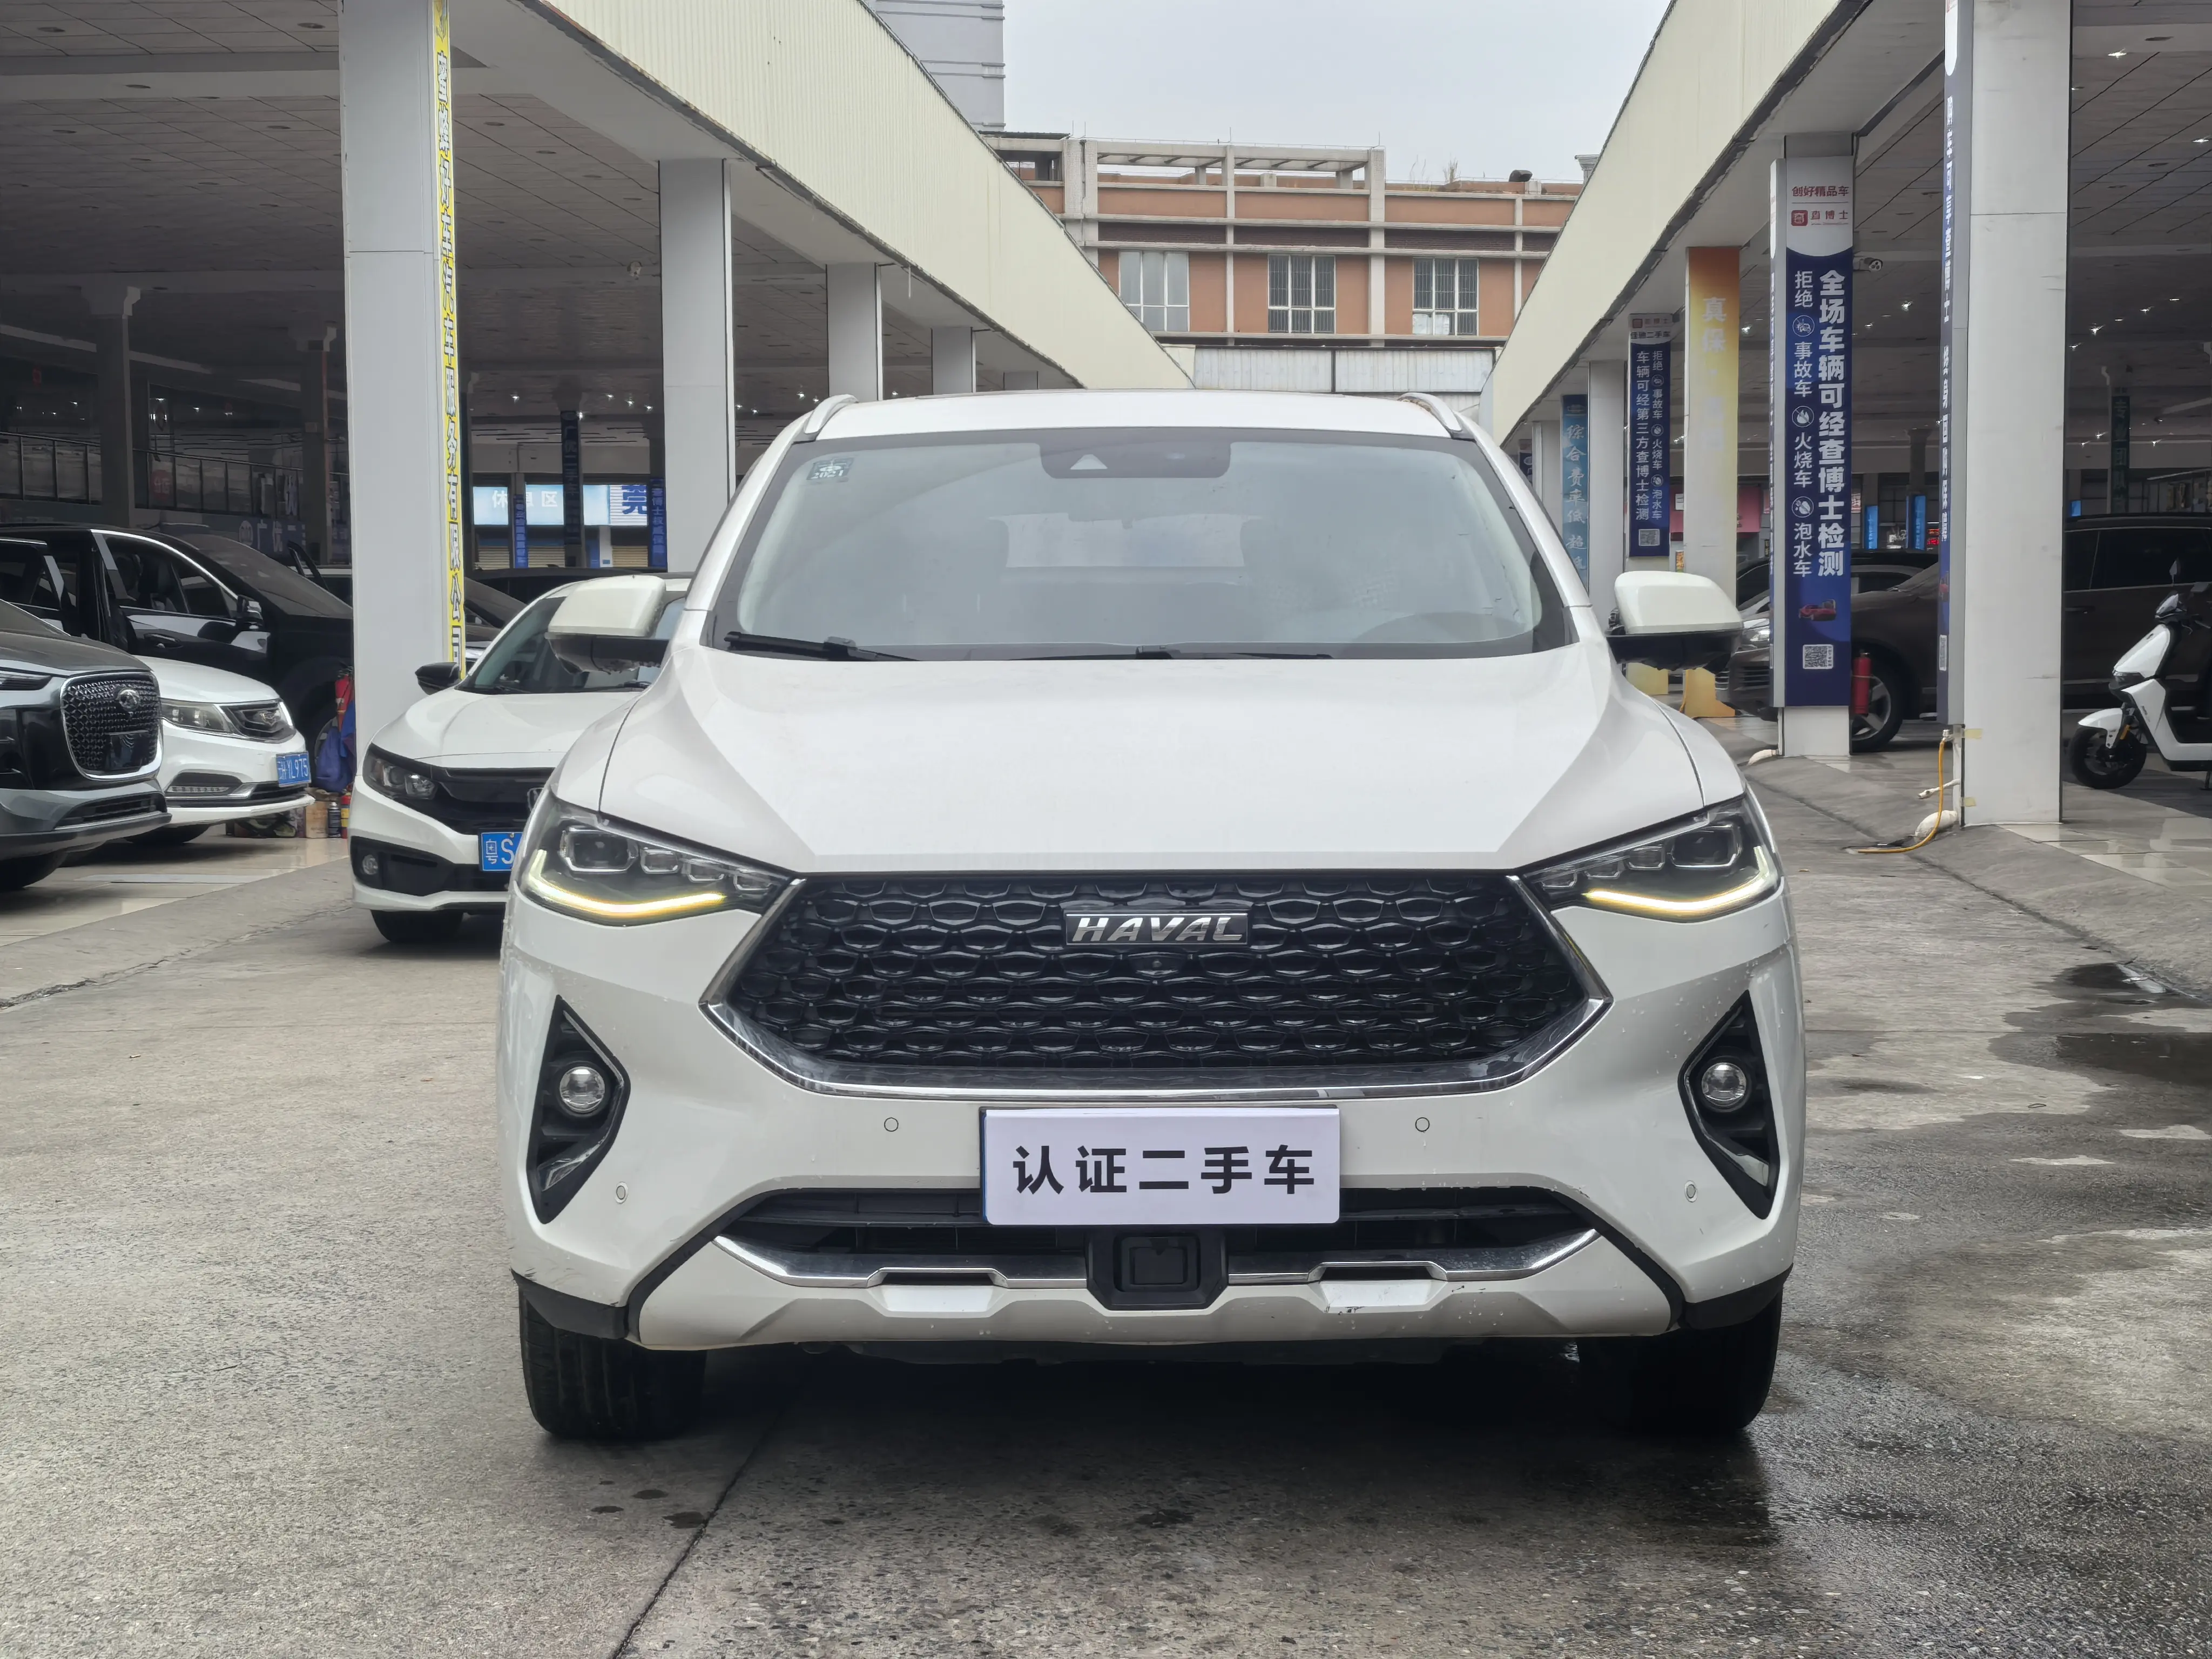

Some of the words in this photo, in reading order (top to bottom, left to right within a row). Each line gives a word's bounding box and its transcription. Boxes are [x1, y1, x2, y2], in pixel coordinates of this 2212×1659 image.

[1792, 186, 1849, 197] 创好精品车
[1795, 271, 1813, 308] 拒绝
[1653, 350, 1663, 370] 拒绝
[1794, 342, 1813, 397] 事故车
[1653, 389, 1663, 419] 事故车
[1636, 351, 1650, 521] 车辆可经第三方查博士检测
[1818, 270, 1845, 576] 全场车辆可经查博士检测
[1652, 439, 1663, 470] 火烧车
[1793, 432, 1813, 488] 火烧车
[1651, 489, 1663, 520] 泡水车
[1793, 523, 1813, 577] 泡水车
[1072, 918, 1243, 942] HAVAL
[1013, 1144, 1314, 1195] 认证二手车
